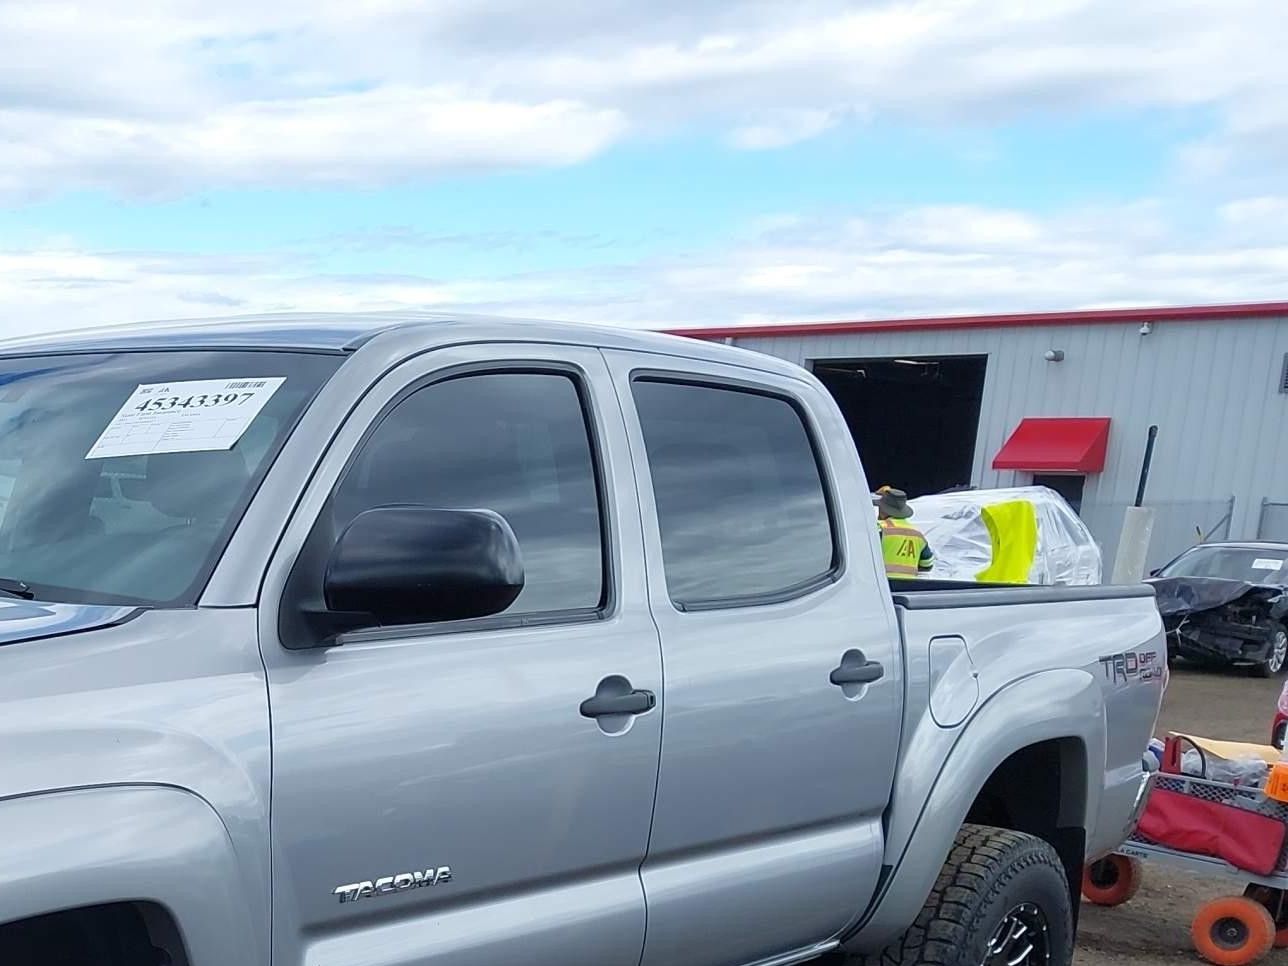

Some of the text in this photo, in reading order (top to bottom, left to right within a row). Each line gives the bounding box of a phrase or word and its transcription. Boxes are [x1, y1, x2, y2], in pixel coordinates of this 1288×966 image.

[135, 392, 255, 411] 45343397
[1098, 652, 1138, 683] TRD
[331, 866, 452, 903] TACOMA
